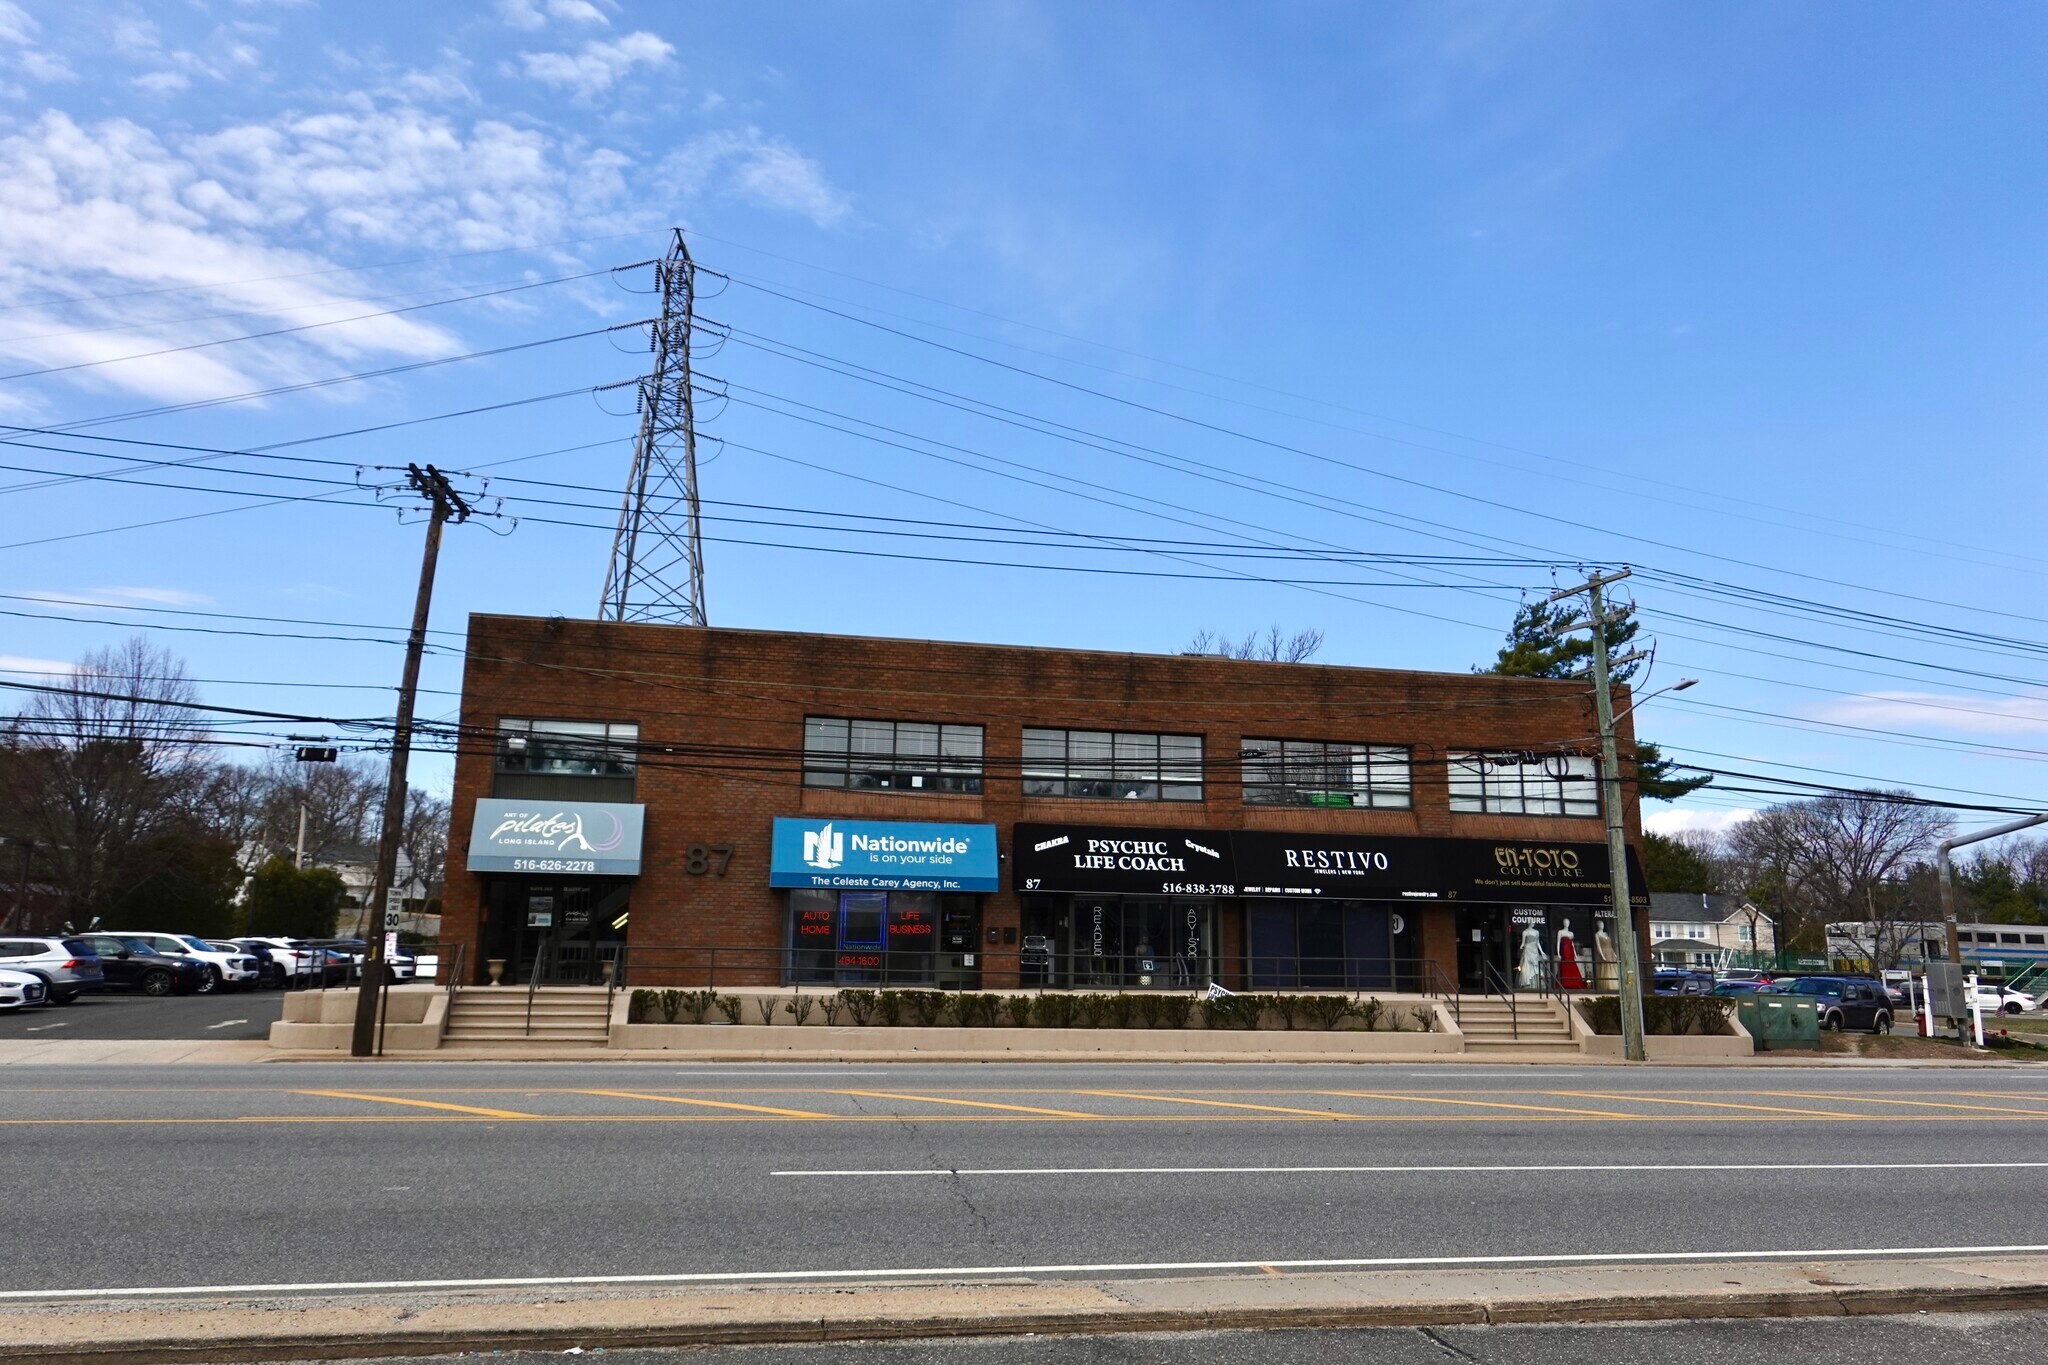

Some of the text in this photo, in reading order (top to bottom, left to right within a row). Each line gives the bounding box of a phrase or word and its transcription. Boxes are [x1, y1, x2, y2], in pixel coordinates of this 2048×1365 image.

[489, 813, 576, 840] pilates
[851, 834, 968, 854] Nationwide
[1034, 835, 1070, 852] CHAKRA
[1087, 839, 1168, 855] PSYCHIC
[1184, 839, 1220, 859] Crystals
[685, 845, 734, 876] 87
[870, 853, 953, 864] is on your side
[1073, 854, 1185, 872] LIFE COACH
[1284, 849, 1389, 870] RESTIVO
[513, 859, 595, 872] 516-626-2278
[811, 876, 961, 890] The Celeste Carey Agency, Inc.
[1025, 878, 1041, 889] 87
[1162, 882, 1235, 894] 516-838-3788
[1447, 891, 1457, 899] 87
[386, 914, 399, 926] 30
[803, 911, 830, 920] AUTO
[900, 911, 920, 920] LIFE
[801, 925, 831, 934] HOME
[889, 925, 931, 934] BUSINESS
